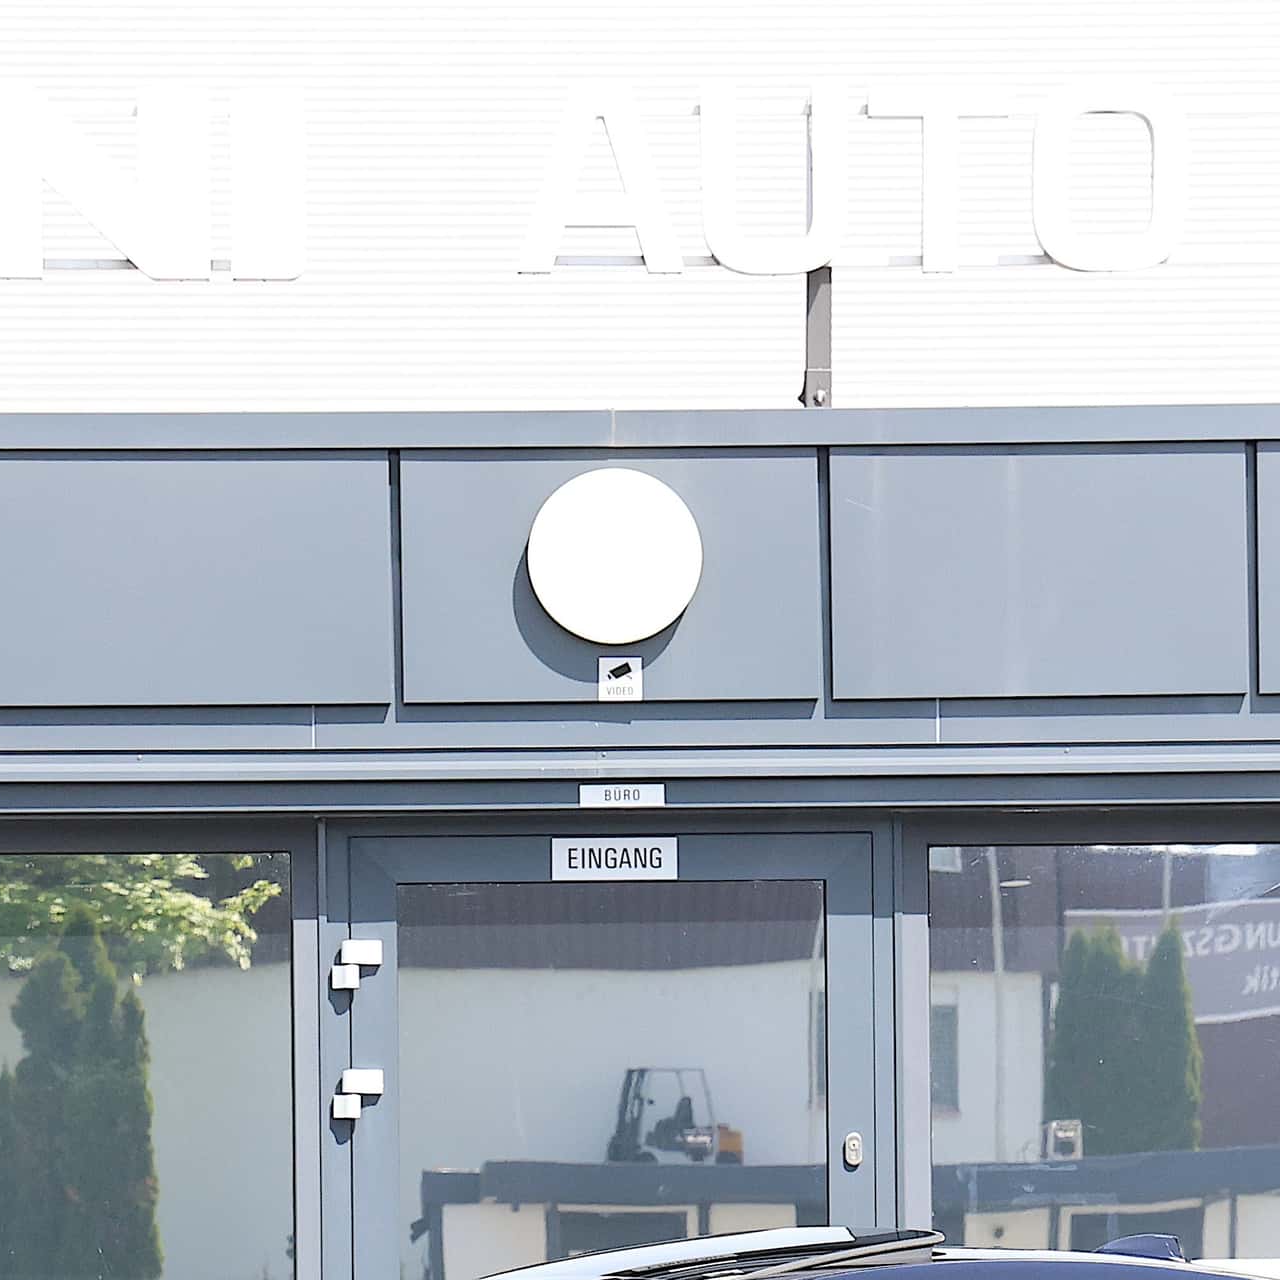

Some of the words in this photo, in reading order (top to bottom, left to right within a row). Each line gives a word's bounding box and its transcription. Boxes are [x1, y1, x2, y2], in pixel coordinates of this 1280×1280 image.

[516, 74, 1176, 276] AUTO
[606, 686, 634, 696] VIDEO
[603, 787, 641, 802] BÜRO
[567, 847, 663, 870] EINGANG
